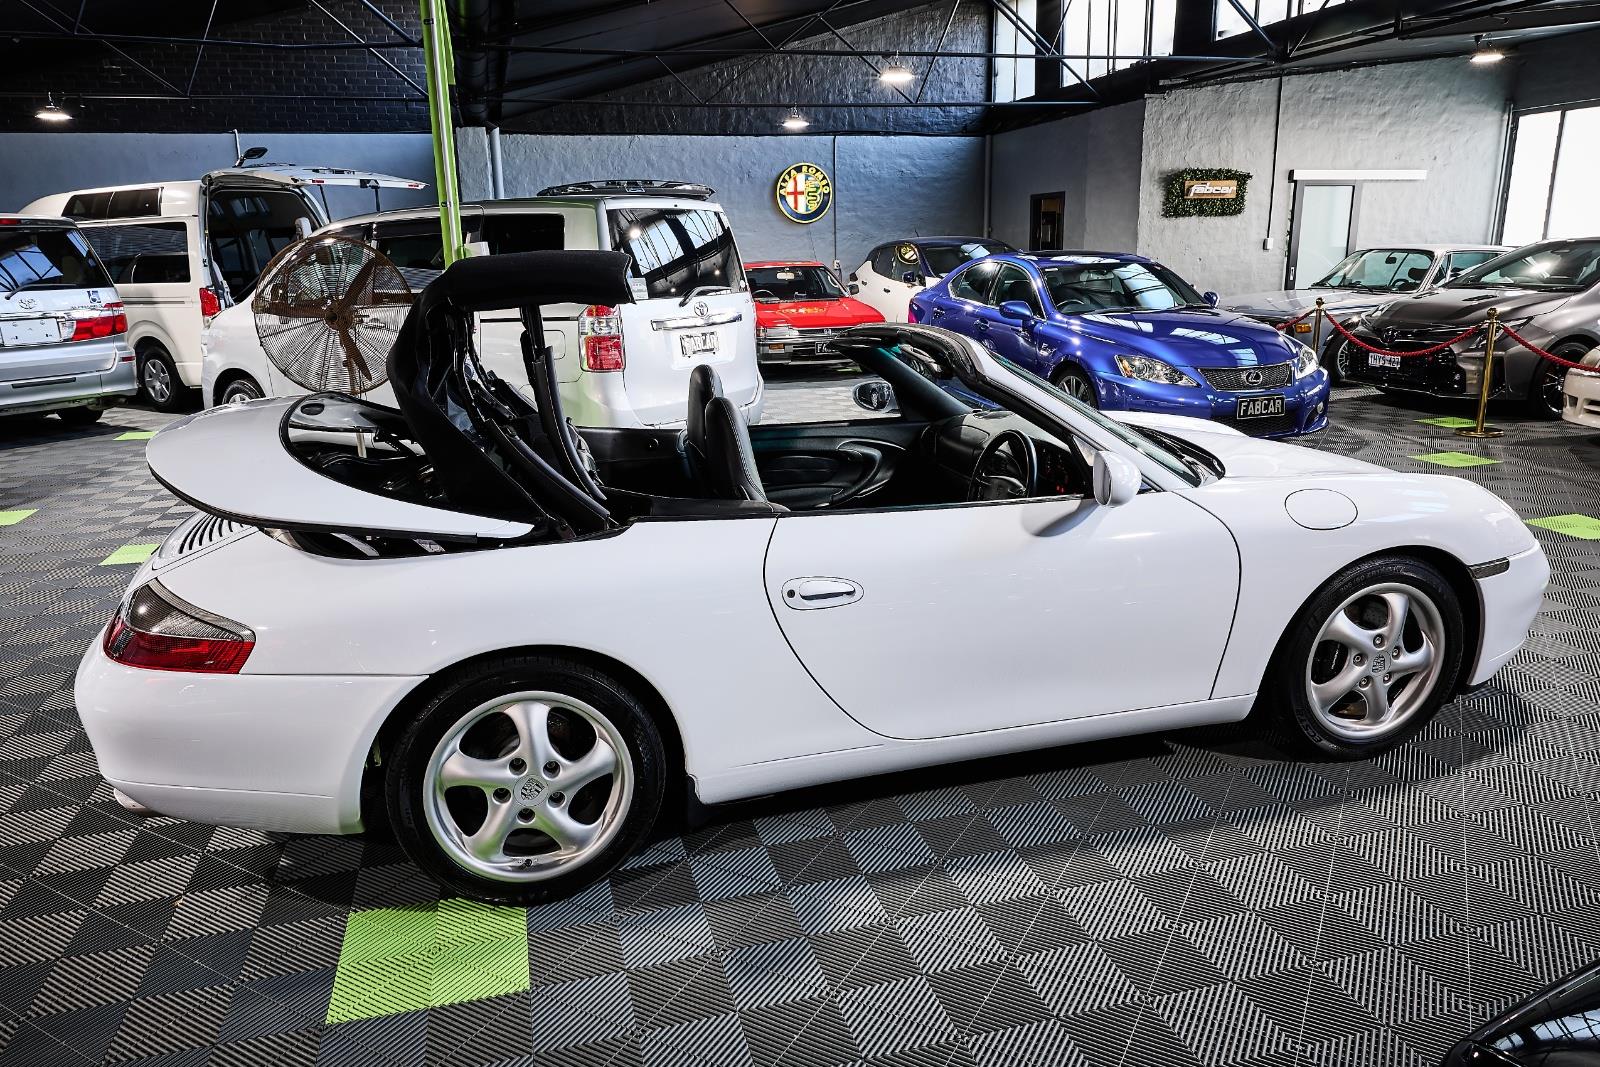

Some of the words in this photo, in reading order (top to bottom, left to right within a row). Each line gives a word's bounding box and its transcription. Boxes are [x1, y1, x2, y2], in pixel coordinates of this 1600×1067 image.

[779, 169, 798, 195] ALFA
[801, 165, 830, 193] ROMEO
[1190, 182, 1237, 197] fabcar
[1240, 399, 1282, 416] FABCAR
